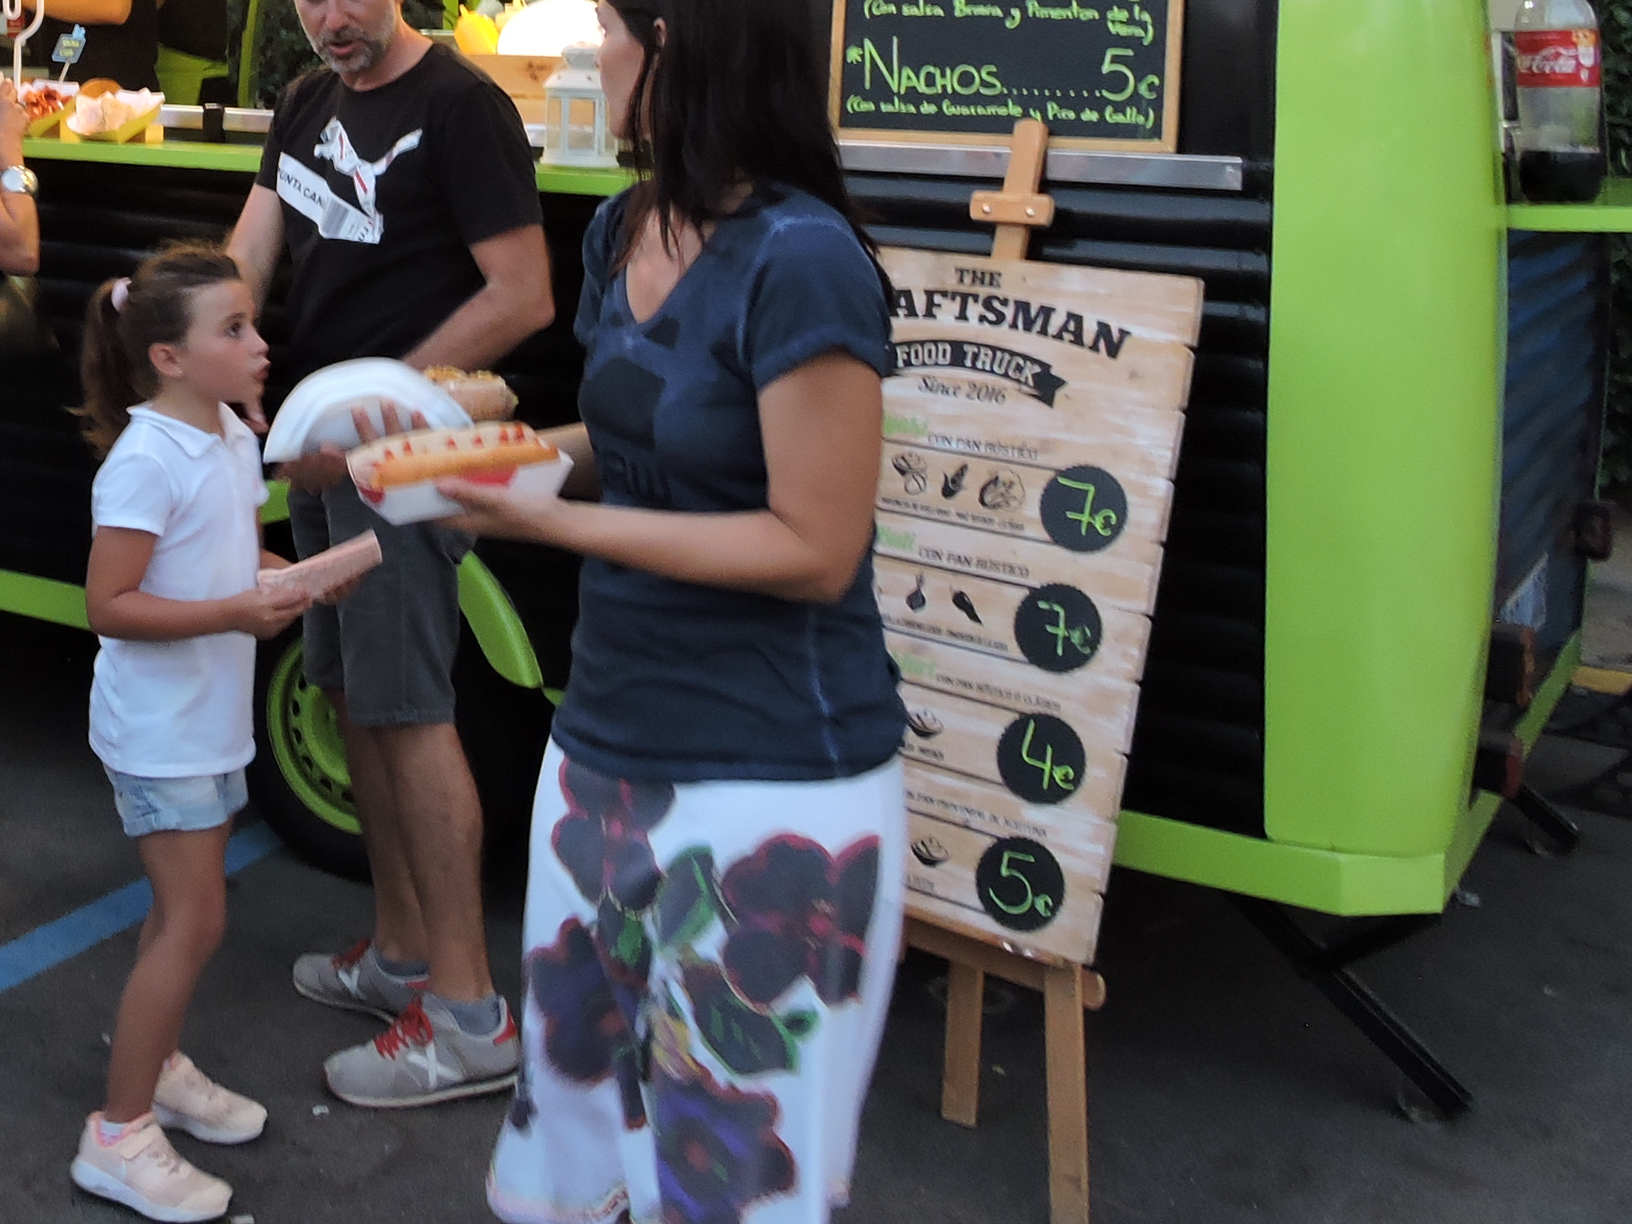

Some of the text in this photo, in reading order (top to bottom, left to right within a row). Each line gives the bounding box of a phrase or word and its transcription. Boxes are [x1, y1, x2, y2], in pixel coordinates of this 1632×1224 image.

[278, 168, 302, 194] UNTA
[955, 268, 1002, 288] THE
[891, 288, 1131, 359] AFTSMAN
[896, 342, 1042, 387] FOOD TRUCK
